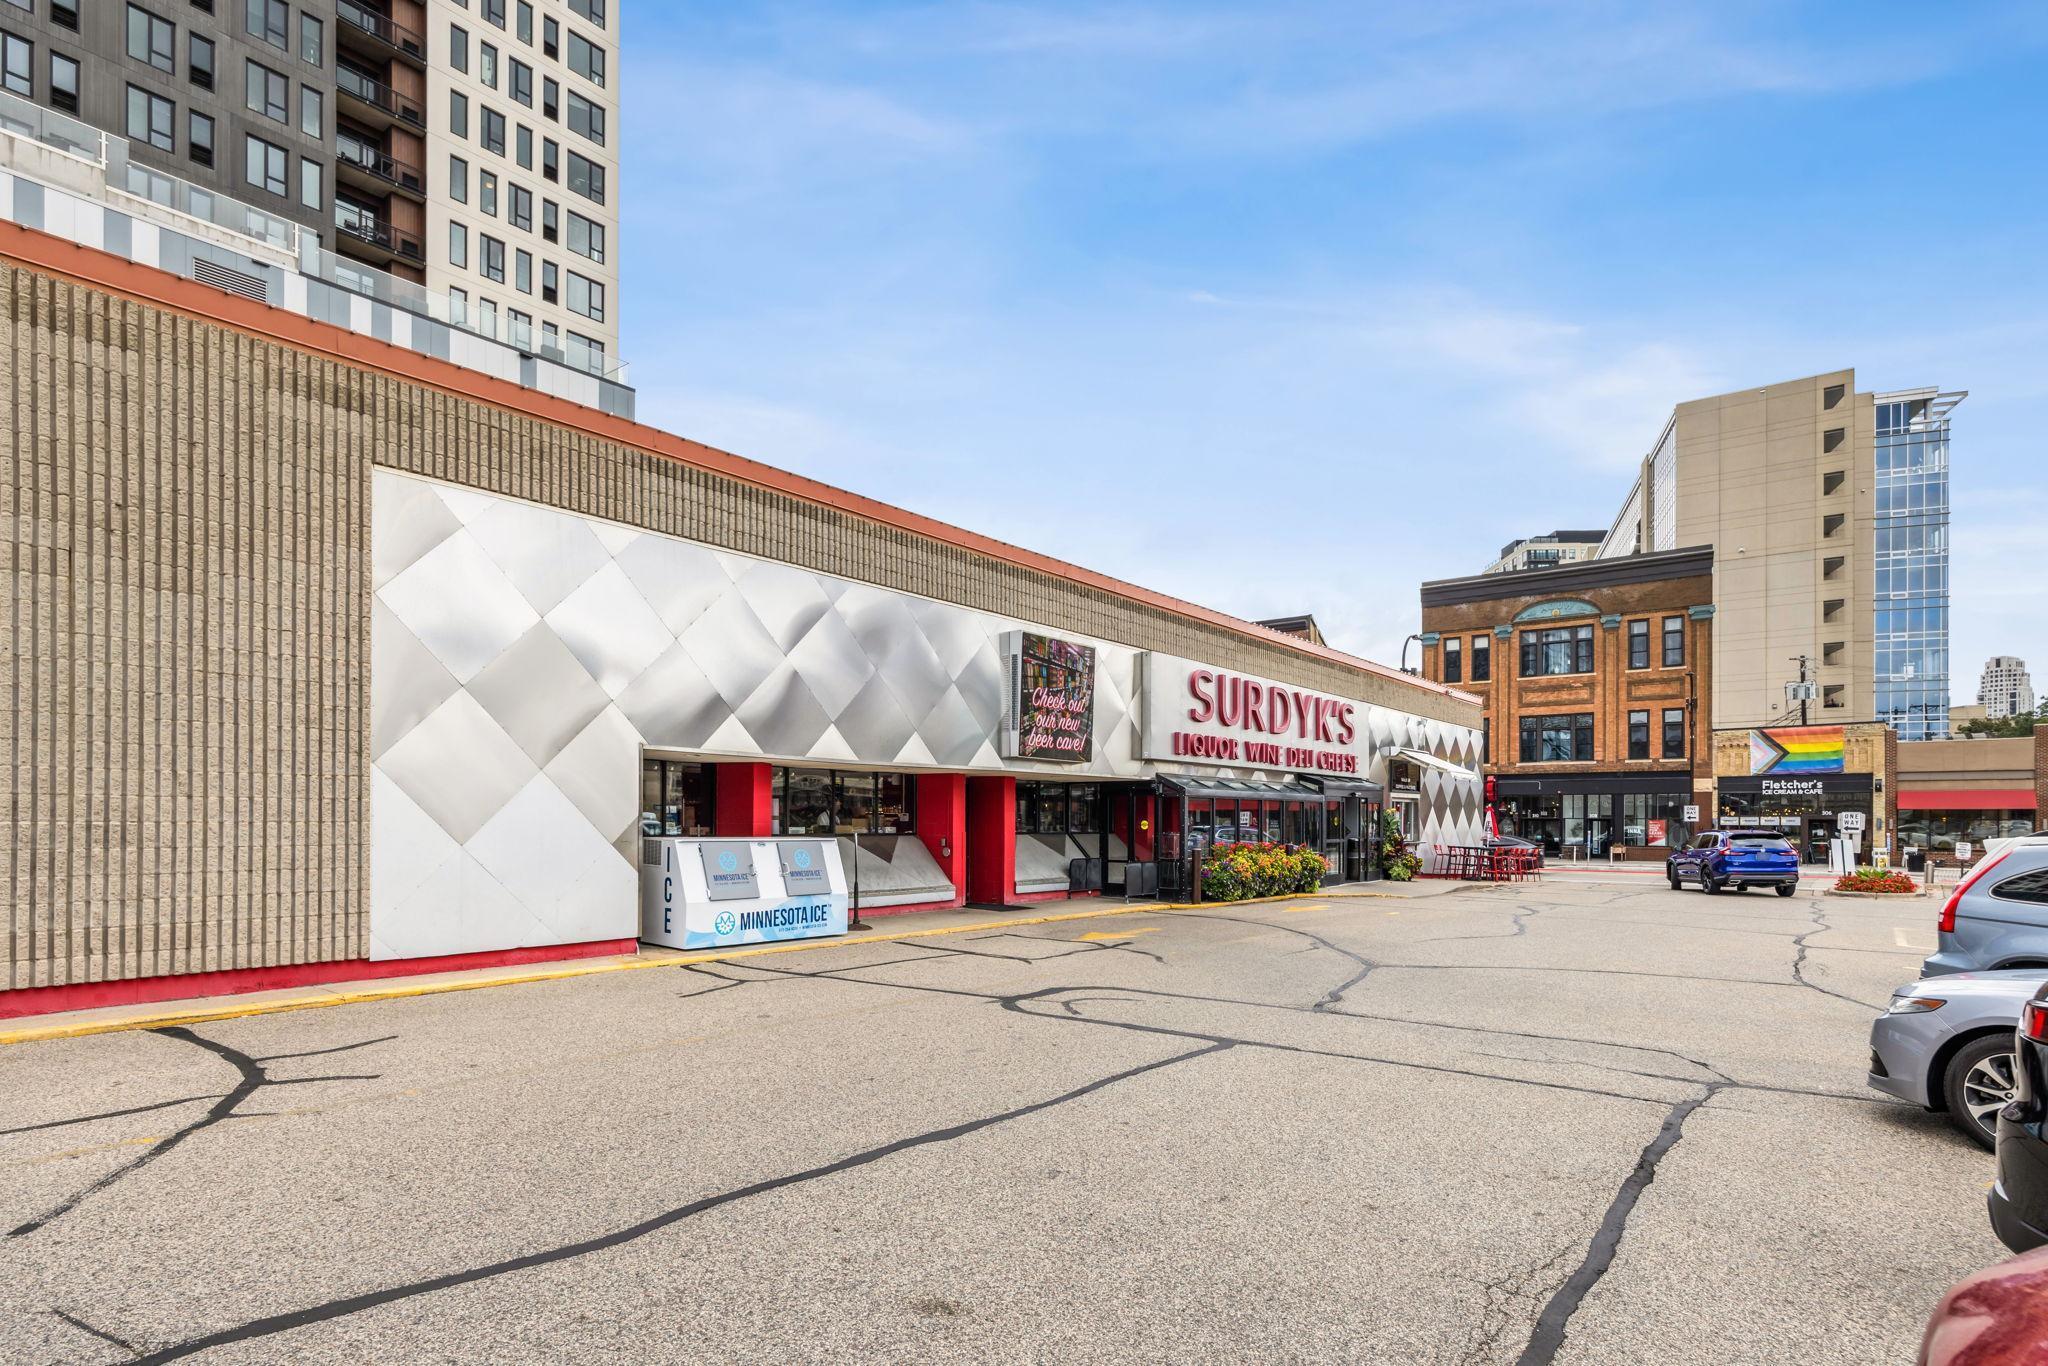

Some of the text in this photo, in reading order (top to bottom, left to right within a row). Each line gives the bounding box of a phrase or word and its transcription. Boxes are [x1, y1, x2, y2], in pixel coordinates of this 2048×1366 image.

[1032, 687, 1086, 713] Check out
[1189, 669, 1355, 745] SURDYK'S
[1036, 714, 1080, 731] our new
[1028, 727, 1087, 751] beer cave!
[1173, 731, 1359, 773] LIQUOR WINE DELI CHEESE
[1762, 780, 1823, 789] Fletcher's
[664, 847, 672, 934] ICE
[740, 907, 807, 931] MINNESOTA
